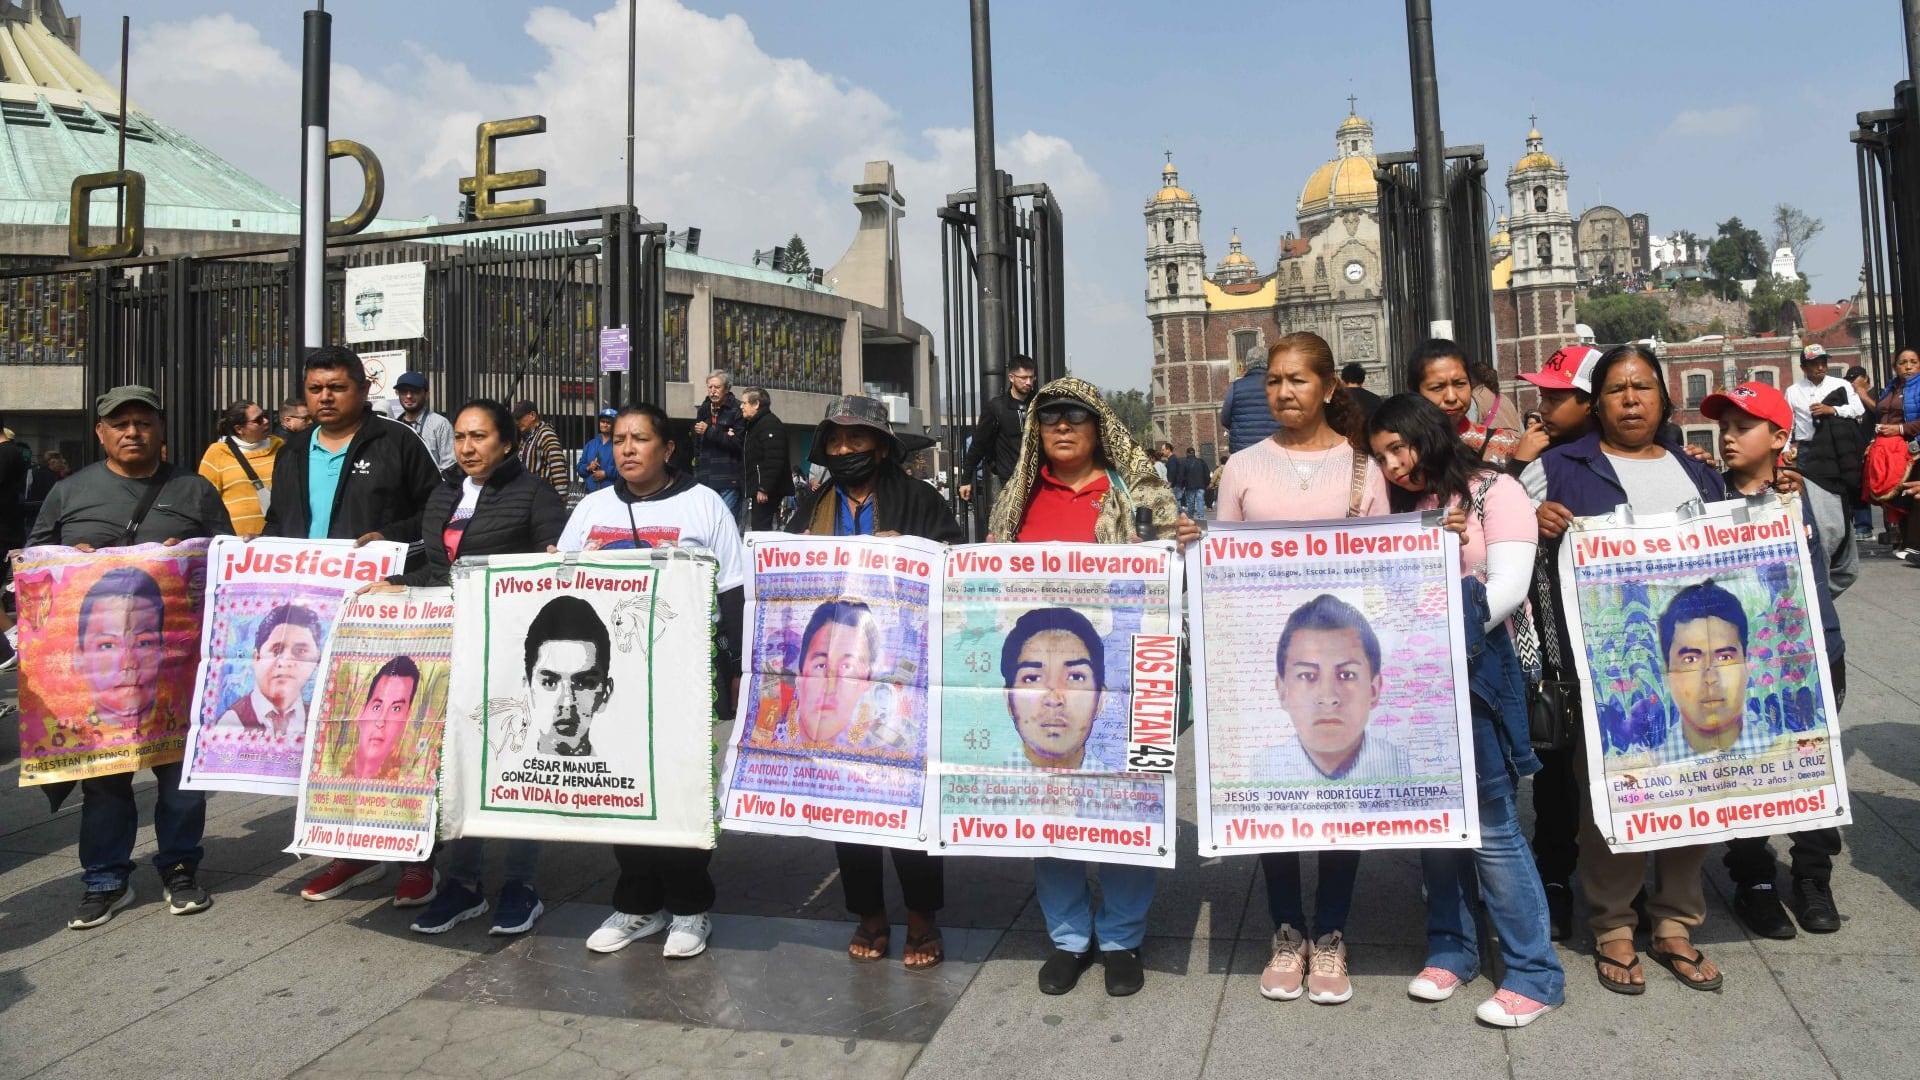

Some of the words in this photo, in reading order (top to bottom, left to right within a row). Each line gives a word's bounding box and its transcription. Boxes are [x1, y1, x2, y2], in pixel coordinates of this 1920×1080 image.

[1204, 537, 1263, 565] ¡Vivo
[1271, 541, 1299, 558] se
[1306, 533, 1328, 556] lo
[1335, 529, 1440, 555] llevaron!
[1577, 536, 1637, 566] ¡Vivo
[1644, 535, 1671, 554] se
[1677, 531, 1700, 551] lo
[1704, 514, 1791, 548] llevaron!
[224, 547, 392, 582] ¡Justicia!
[757, 547, 801, 573] ¡Vivo
[805, 551, 828, 566] se
[834, 546, 850, 566] lo
[948, 551, 1002, 577] ¡Vivo
[1009, 557, 1035, 573] se
[1041, 551, 1061, 573] lo
[1068, 551, 1166, 574] llevaron!
[1239, 570, 1264, 578] Nimmo,
[1268, 570, 1302, 578] Glasgow,
[1306, 567, 1340, 576] Escocia,
[1344, 566, 1370, 575] quiero
[1373, 564, 1394, 573] saber
[495, 576, 534, 597] ¡Vivo
[537, 578, 552, 592] se
[575, 571, 649, 592] llevaron!
[1005, 586, 1037, 594] Glasgow,
[380, 604, 398, 619] se
[403, 601, 417, 619] lo
[421, 602, 454, 619] lleva
[964, 651, 993, 674] 43
[1136, 635, 1176, 673] NOS
[1133, 679, 1174, 746] FALTAN
[25, 756, 81, 773] CHRISTIAN
[87, 749, 130, 763] ALFONSO
[523, 757, 561, 773] CÉSAR
[562, 761, 611, 774] MANUEL
[747, 763, 789, 777] ANTONIO
[792, 766, 840, 781] SANTANA
[1613, 775, 1673, 792] EMILIANO
[1679, 771, 1708, 784] ALEN
[1713, 765, 1754, 779] GASPAR
[1761, 763, 1776, 774] DE
[1783, 760, 1794, 771] LA
[1799, 754, 1827, 768] CRUZ
[501, 769, 559, 786] GONZÁLEZ
[562, 773, 635, 790] HERNÁNDEZ
[948, 782, 978, 794] José
[986, 782, 1039, 796] Eduardo
[1046, 782, 1095, 799] Bartolo
[1101, 787, 1159, 803] Tlatempa
[1618, 794, 1640, 804] Hijo
[1643, 792, 1655, 801] de
[1658, 789, 1685, 799] Celso
[1688, 788, 1694, 797] y
[1752, 778, 1763, 787] 22
[1767, 774, 1788, 785] años
[1797, 769, 1825, 780] Omeapa
[491, 785, 519, 804] ¡Con
[521, 786, 553, 803] VIDA
[555, 790, 569, 805] lo
[571, 792, 645, 809] queremos!
[1224, 789, 1260, 802] JESÚS
[1266, 790, 1310, 801] JOVANY
[1316, 787, 1381, 800] RODRÍGUEZ
[1387, 785, 1448, 798] TLATEMPA
[1242, 803, 1260, 812] Hijo
[1264, 803, 1273, 811] de
[1358, 801, 1368, 809] 20
[735, 794, 775, 818] ¡Vivo
[780, 797, 796, 818] lo
[802, 803, 908, 830] queremos!
[1626, 811, 1683, 841] ¡Vivo
[1689, 806, 1710, 828] lo
[1716, 789, 1826, 829] queremos!
[304, 825, 333, 847] ¡Vivo
[335, 827, 346, 845] lo
[346, 833, 420, 853] queremos!
[952, 816, 1008, 843] ¡Vivo
[1015, 818, 1036, 840] lo
[1042, 824, 1151, 847] queremos!
[1225, 818, 1284, 845] ¡Vivo
[1292, 817, 1314, 840] lo
[1321, 813, 1449, 844] queremos!
